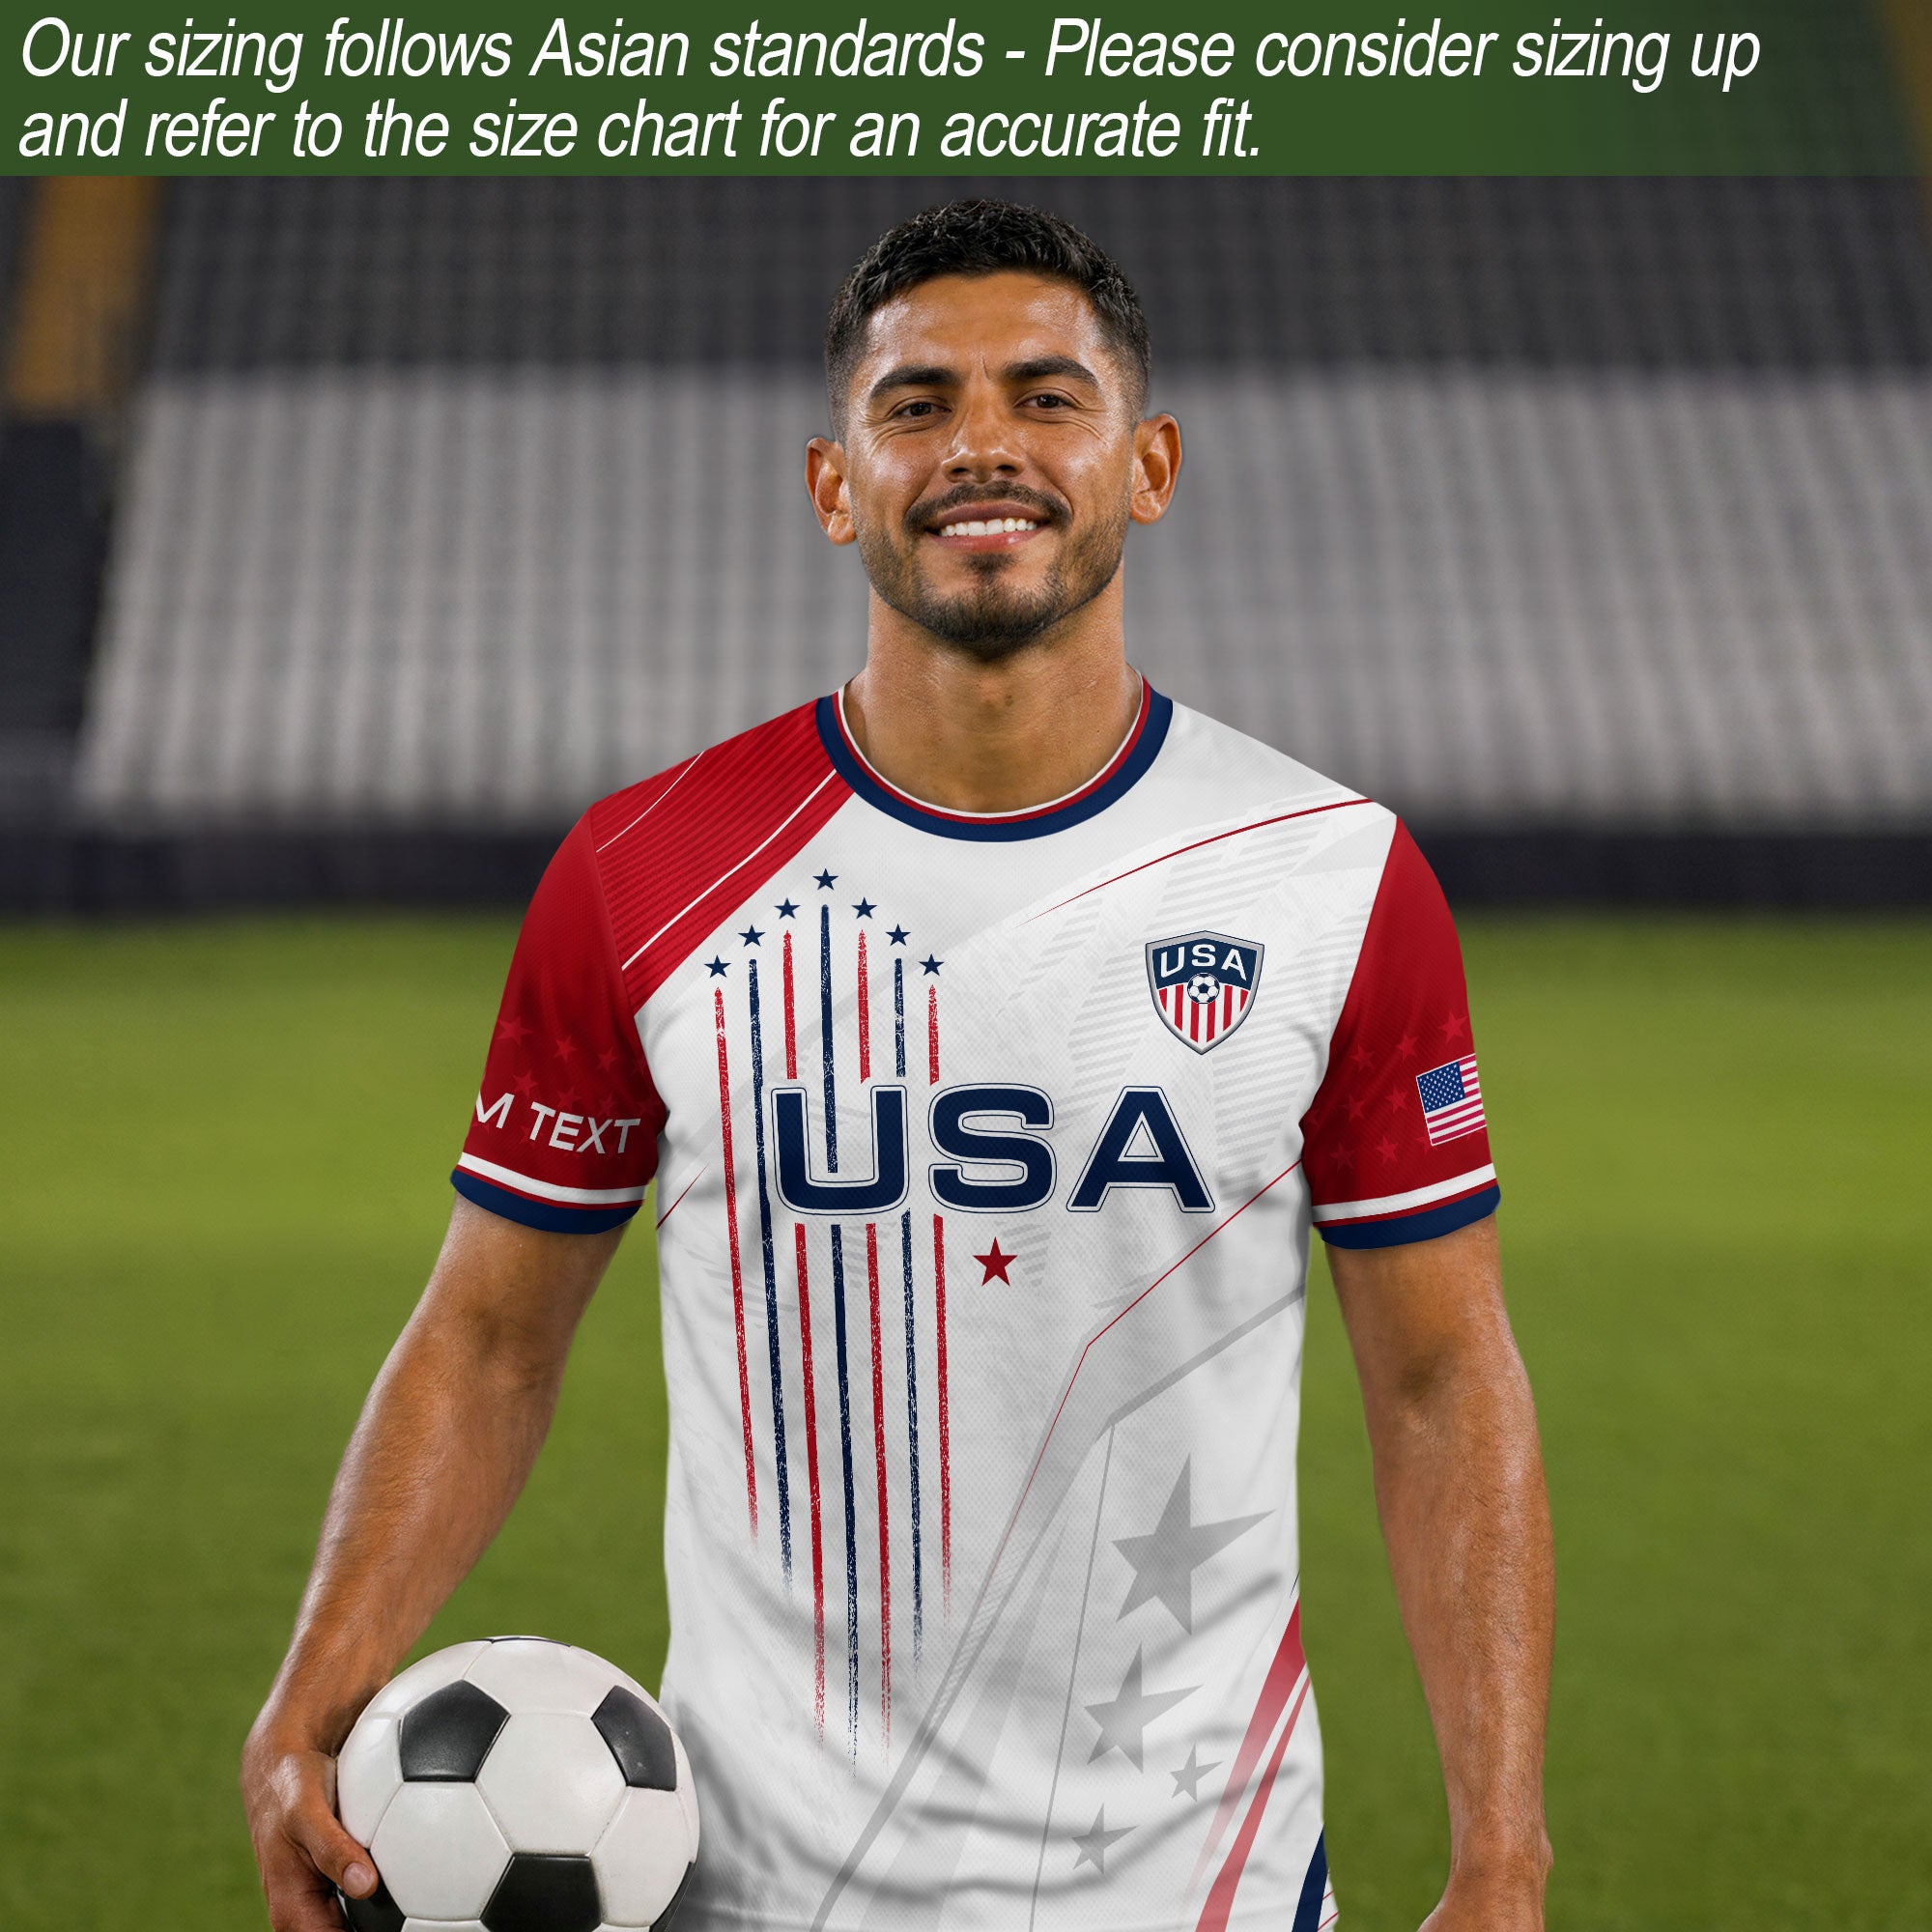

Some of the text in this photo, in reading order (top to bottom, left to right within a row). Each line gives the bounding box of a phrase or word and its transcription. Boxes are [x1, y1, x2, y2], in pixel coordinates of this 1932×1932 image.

[1159, 943, 1247, 981] USA
[528, 1101, 641, 1154] TEXT
[771, 1083, 1215, 1215] USA
